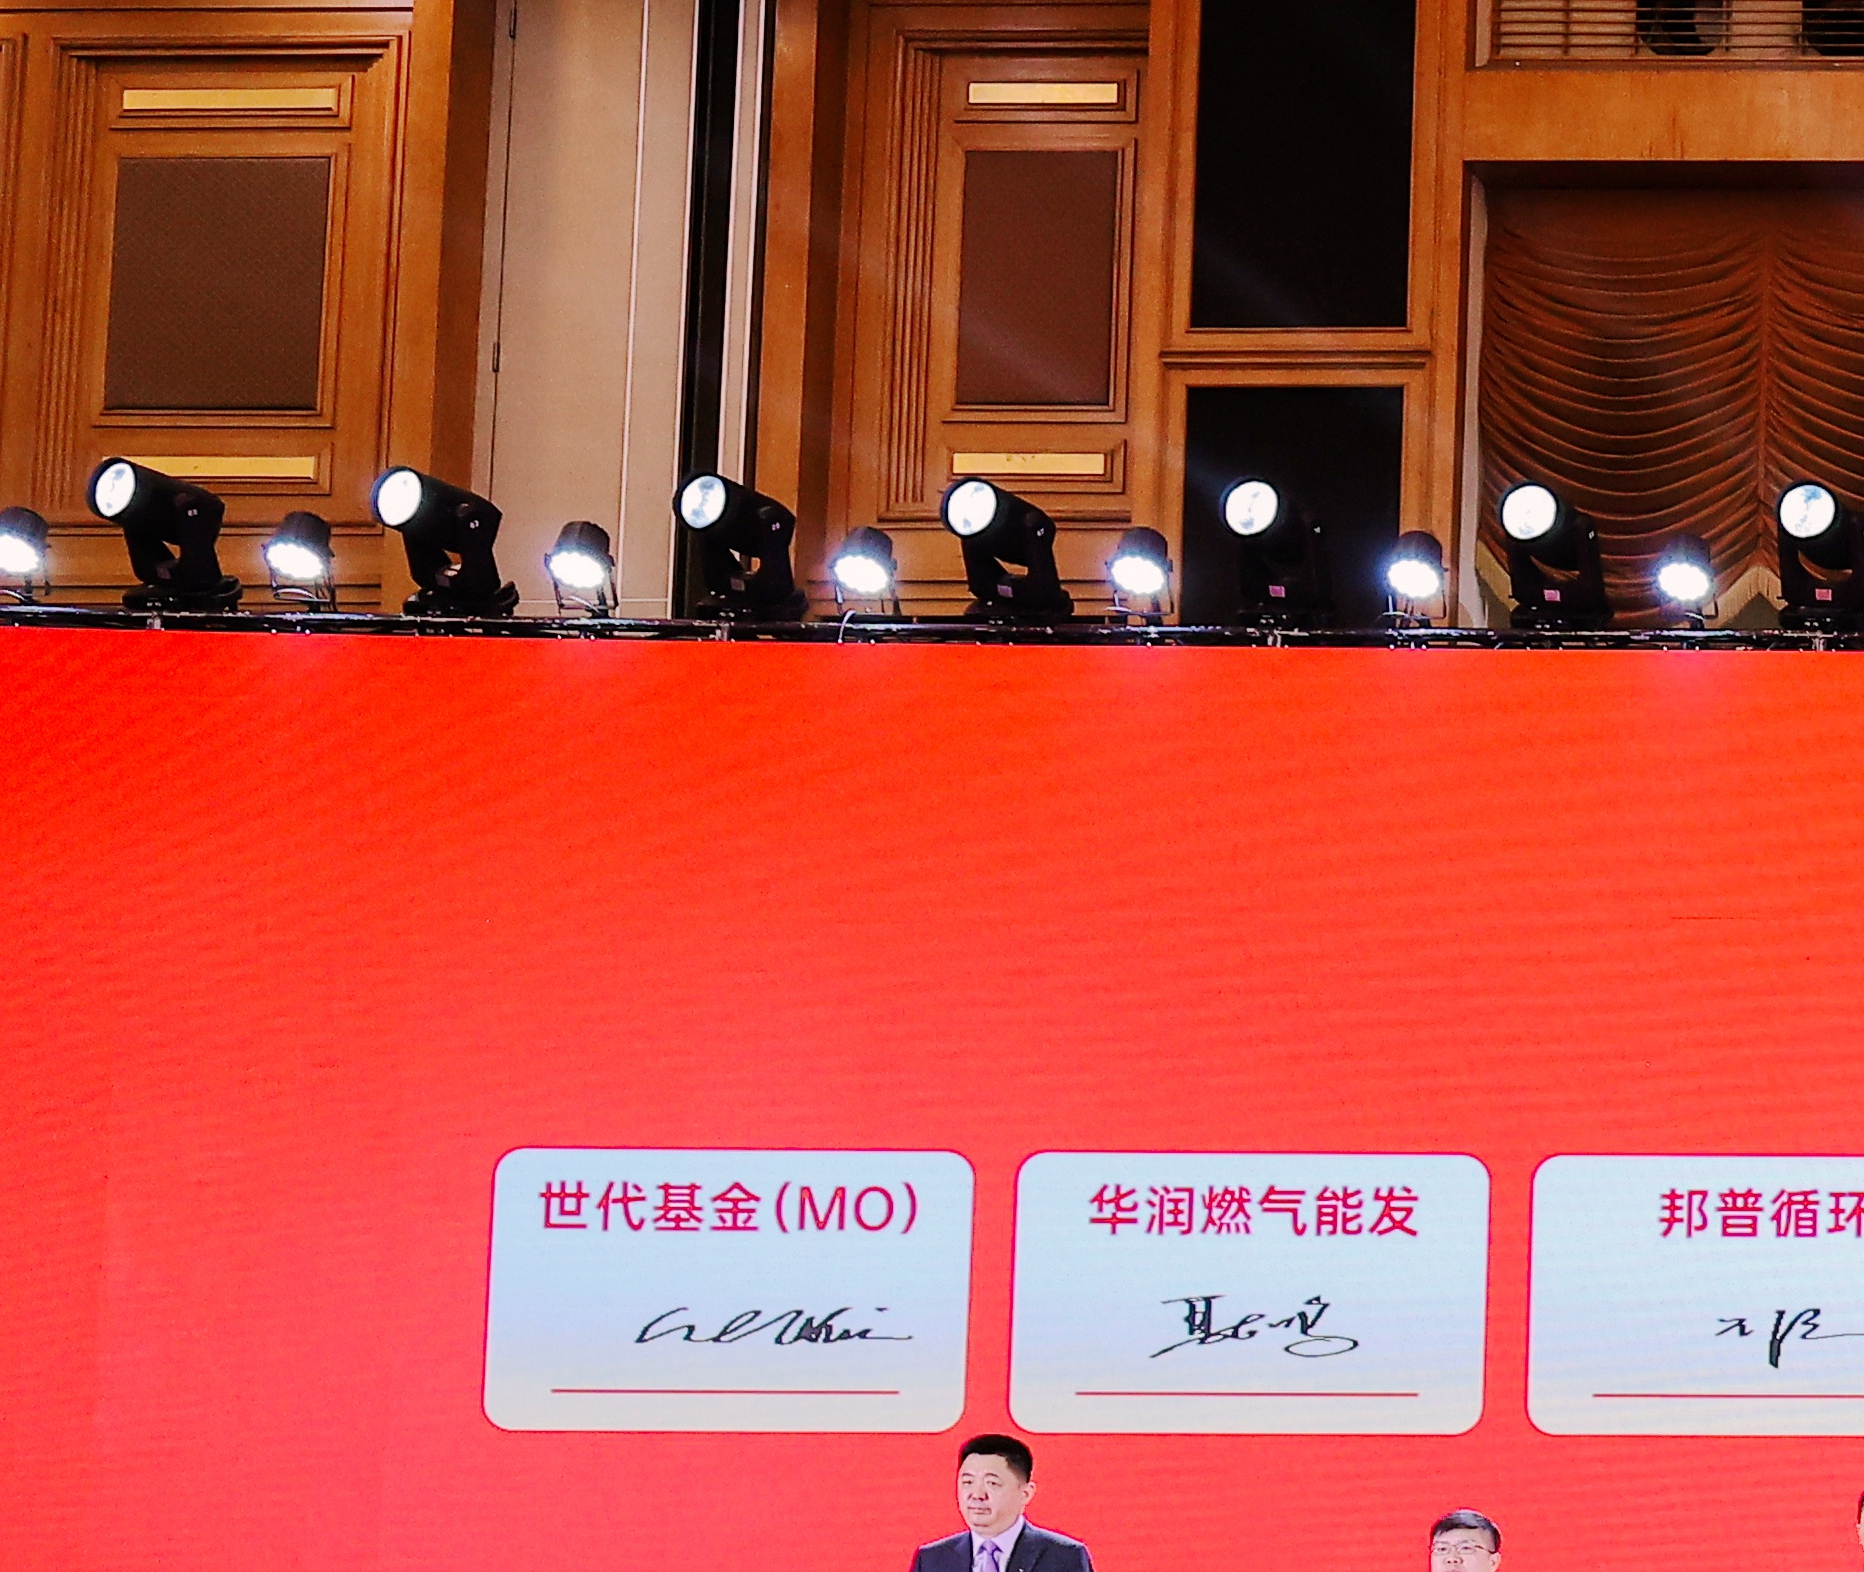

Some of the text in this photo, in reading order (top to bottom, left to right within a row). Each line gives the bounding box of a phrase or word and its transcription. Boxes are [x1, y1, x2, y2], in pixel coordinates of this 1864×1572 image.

[539, 1180, 919, 1235] 世代基金(MO)
[1088, 1184, 1420, 1237] 华润燃气能发
